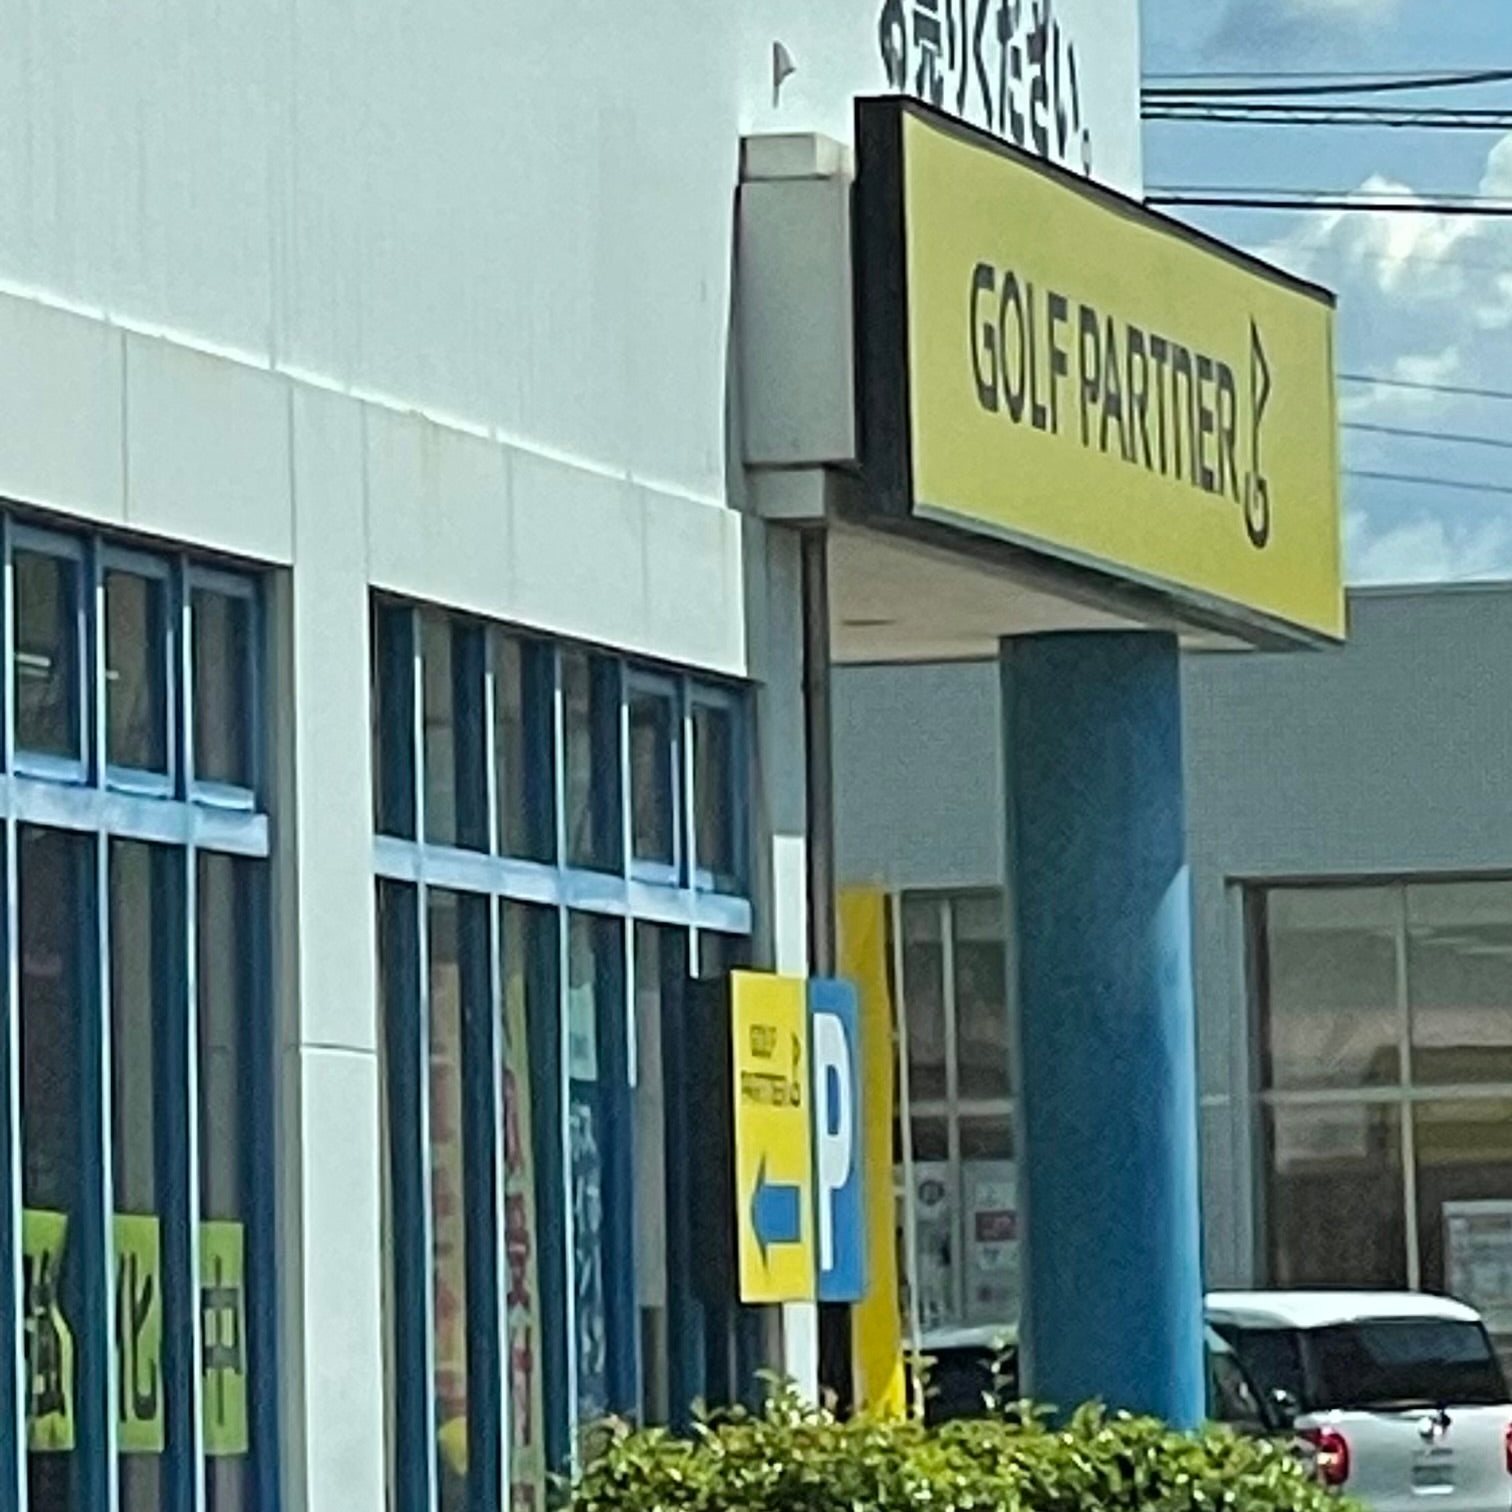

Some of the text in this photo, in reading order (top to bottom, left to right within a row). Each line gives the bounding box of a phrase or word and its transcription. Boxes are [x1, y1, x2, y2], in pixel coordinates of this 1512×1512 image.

[969, 262, 1240, 504] GOLF PARTNER
[812, 1012, 851, 1272] P
